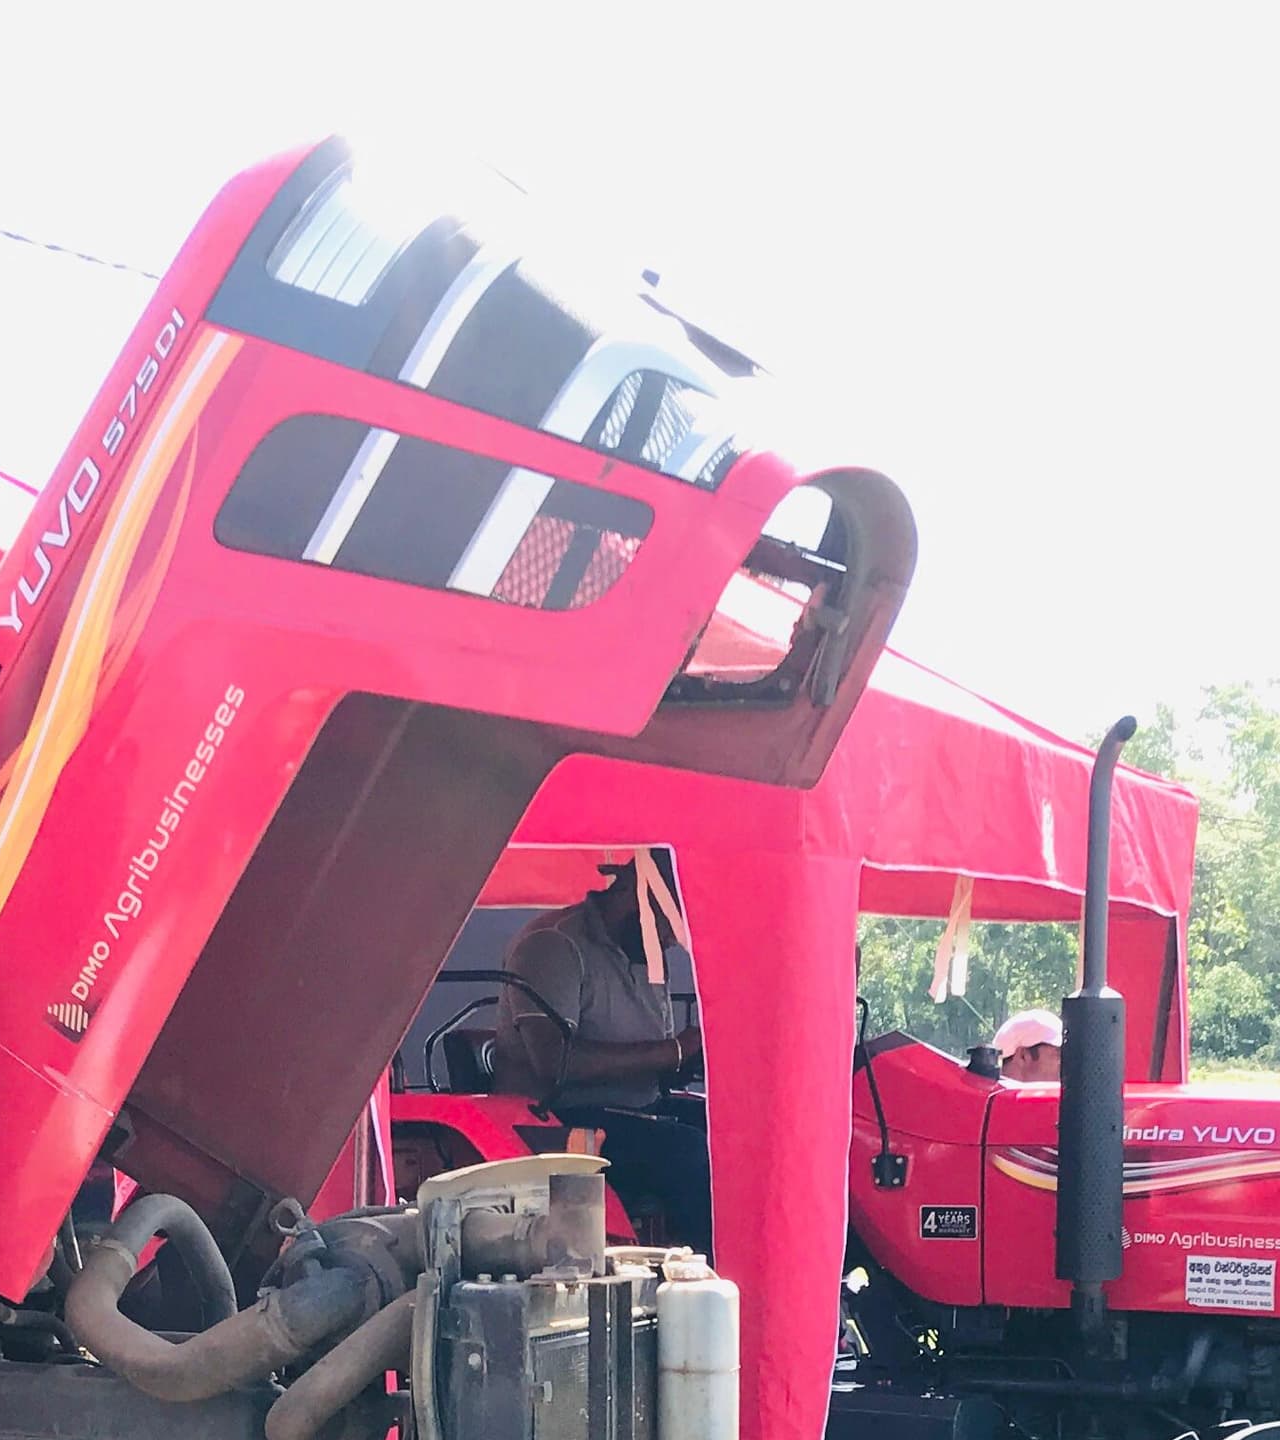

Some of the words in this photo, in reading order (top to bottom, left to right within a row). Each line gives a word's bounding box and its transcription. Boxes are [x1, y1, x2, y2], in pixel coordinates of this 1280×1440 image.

[71, 940, 111, 1002] DIMO
[103, 684, 245, 939] Agribusinesses
[1122, 1125, 1185, 1142] indra
[1192, 1126, 1276, 1144] YUVO
[923, 1211, 938, 1233] 4
[938, 1215, 971, 1225] YEARS
[1134, 1232, 1166, 1244] DIMO
